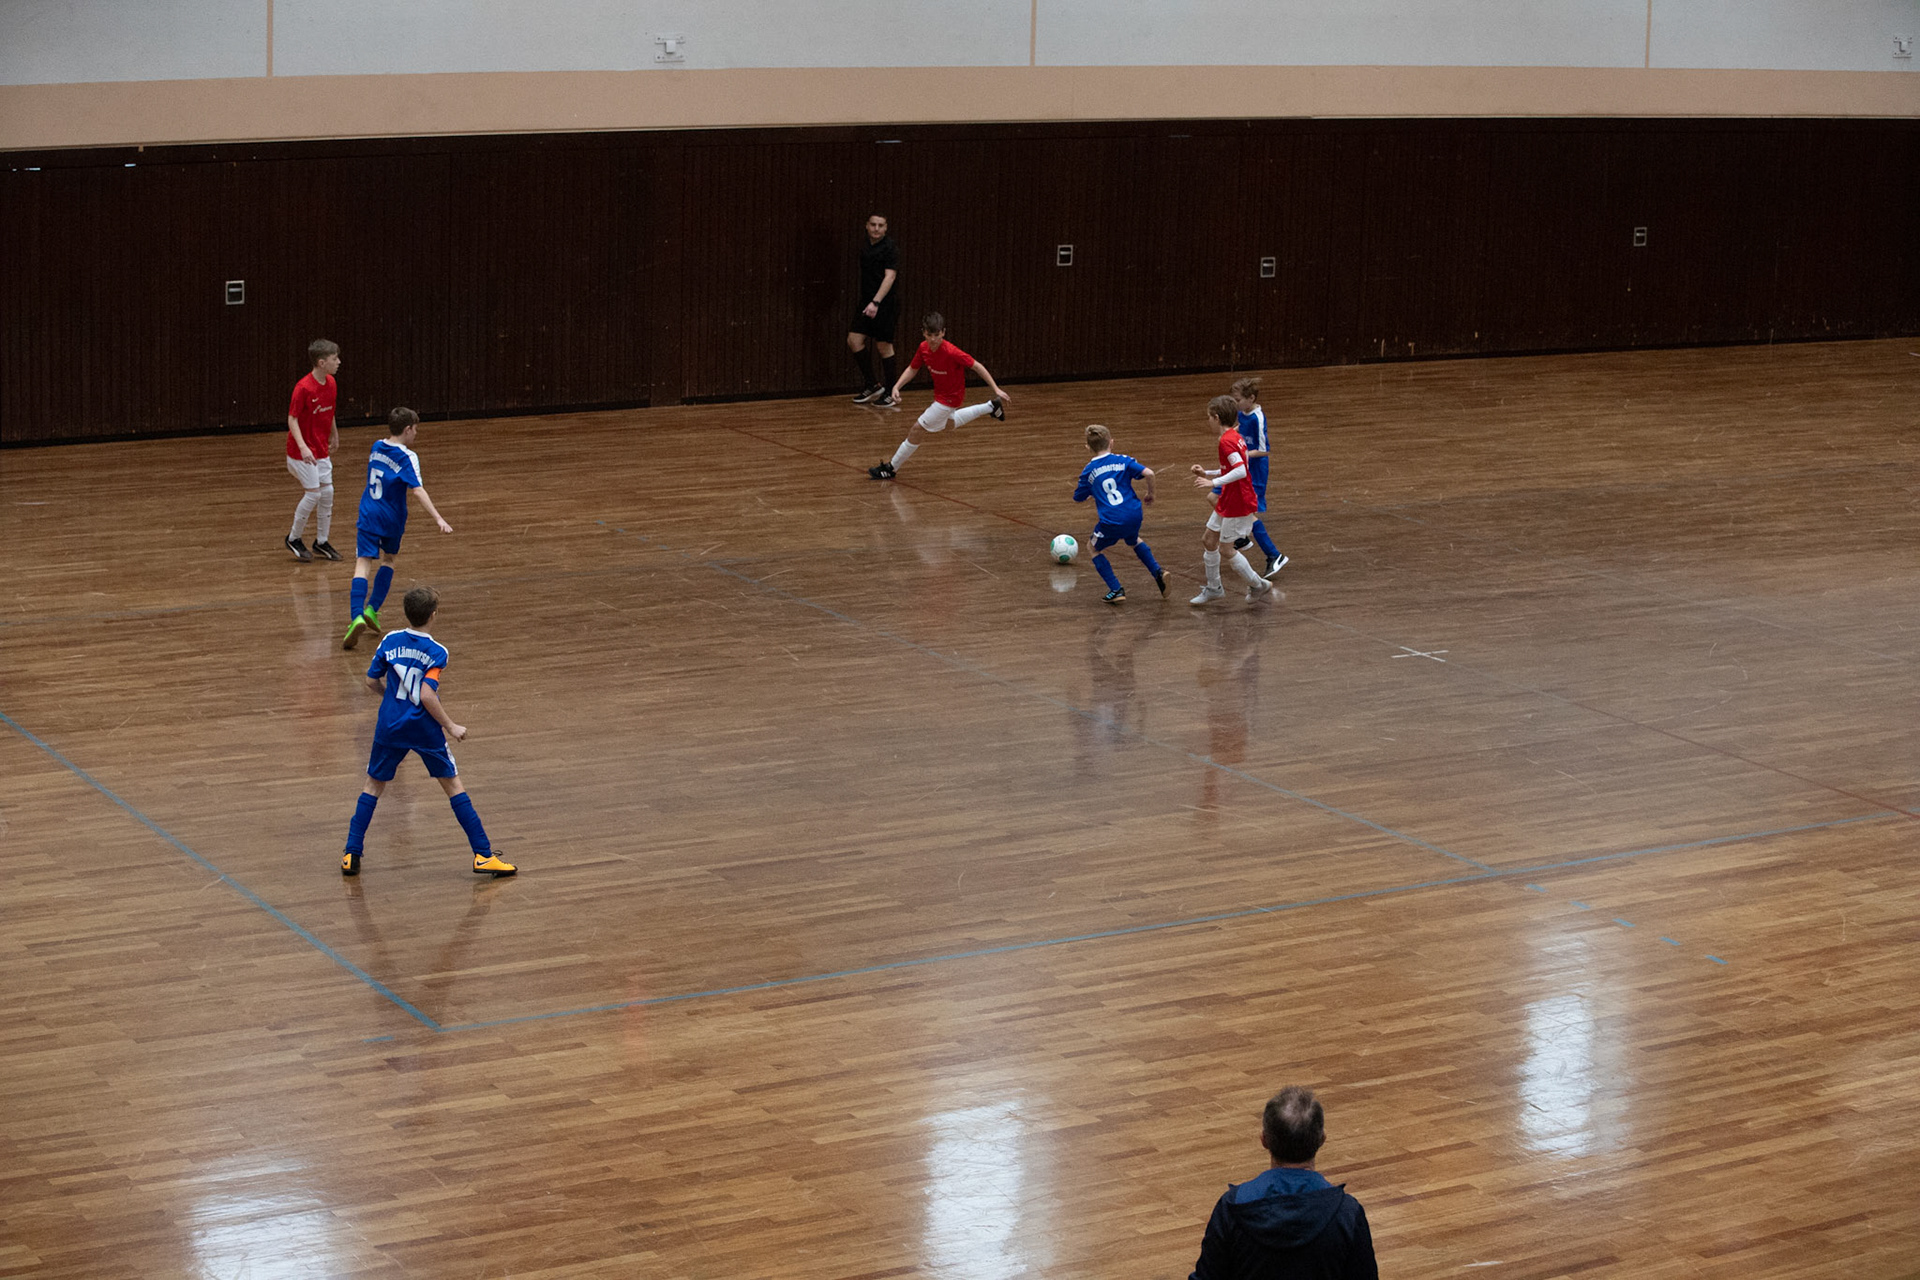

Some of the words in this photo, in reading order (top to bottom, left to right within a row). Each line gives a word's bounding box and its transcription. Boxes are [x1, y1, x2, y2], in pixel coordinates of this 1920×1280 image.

[370, 467, 384, 500] 5
[1102, 477, 1124, 506] 8
[385, 648, 397, 661] TSV
[393, 663, 425, 706] 10
